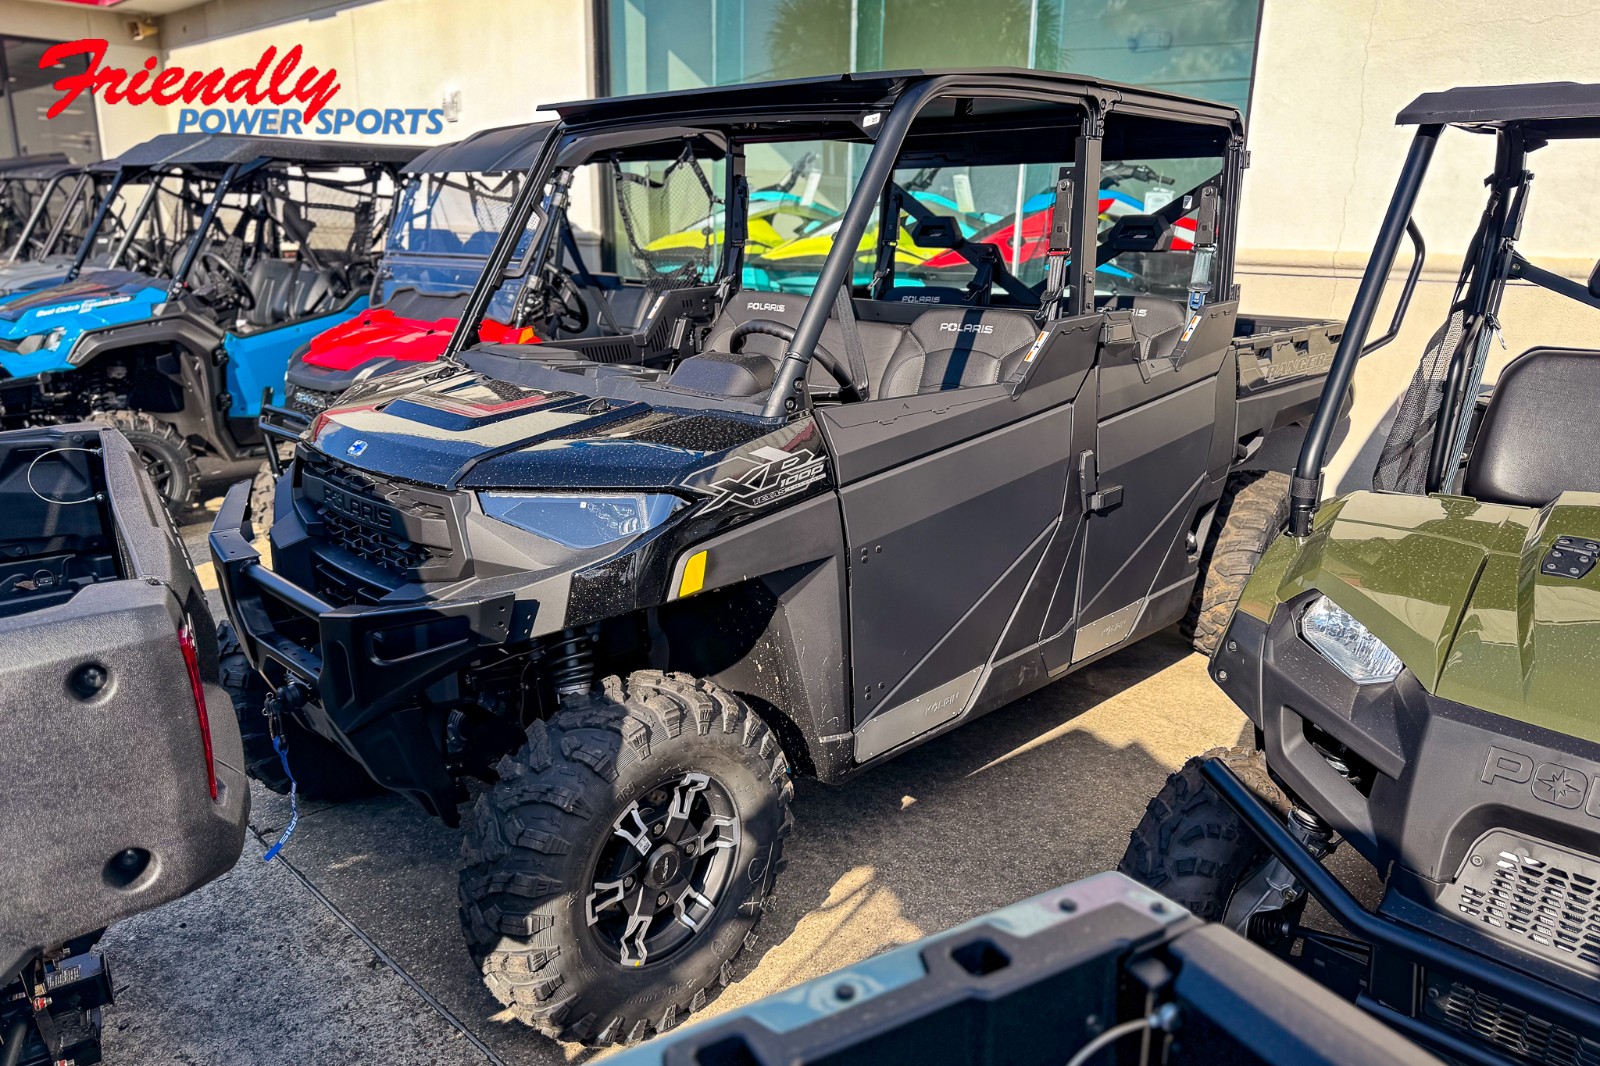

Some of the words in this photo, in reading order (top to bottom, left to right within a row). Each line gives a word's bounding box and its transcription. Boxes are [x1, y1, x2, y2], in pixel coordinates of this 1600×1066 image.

[746, 302, 786, 312] POLARIS
[902, 295, 940, 303] POLARIS
[939, 322, 994, 334] POLARIS
[1265, 353, 1327, 380] RANGER
[780, 463, 825, 488] 1000
[323, 485, 392, 529] POLARIS
